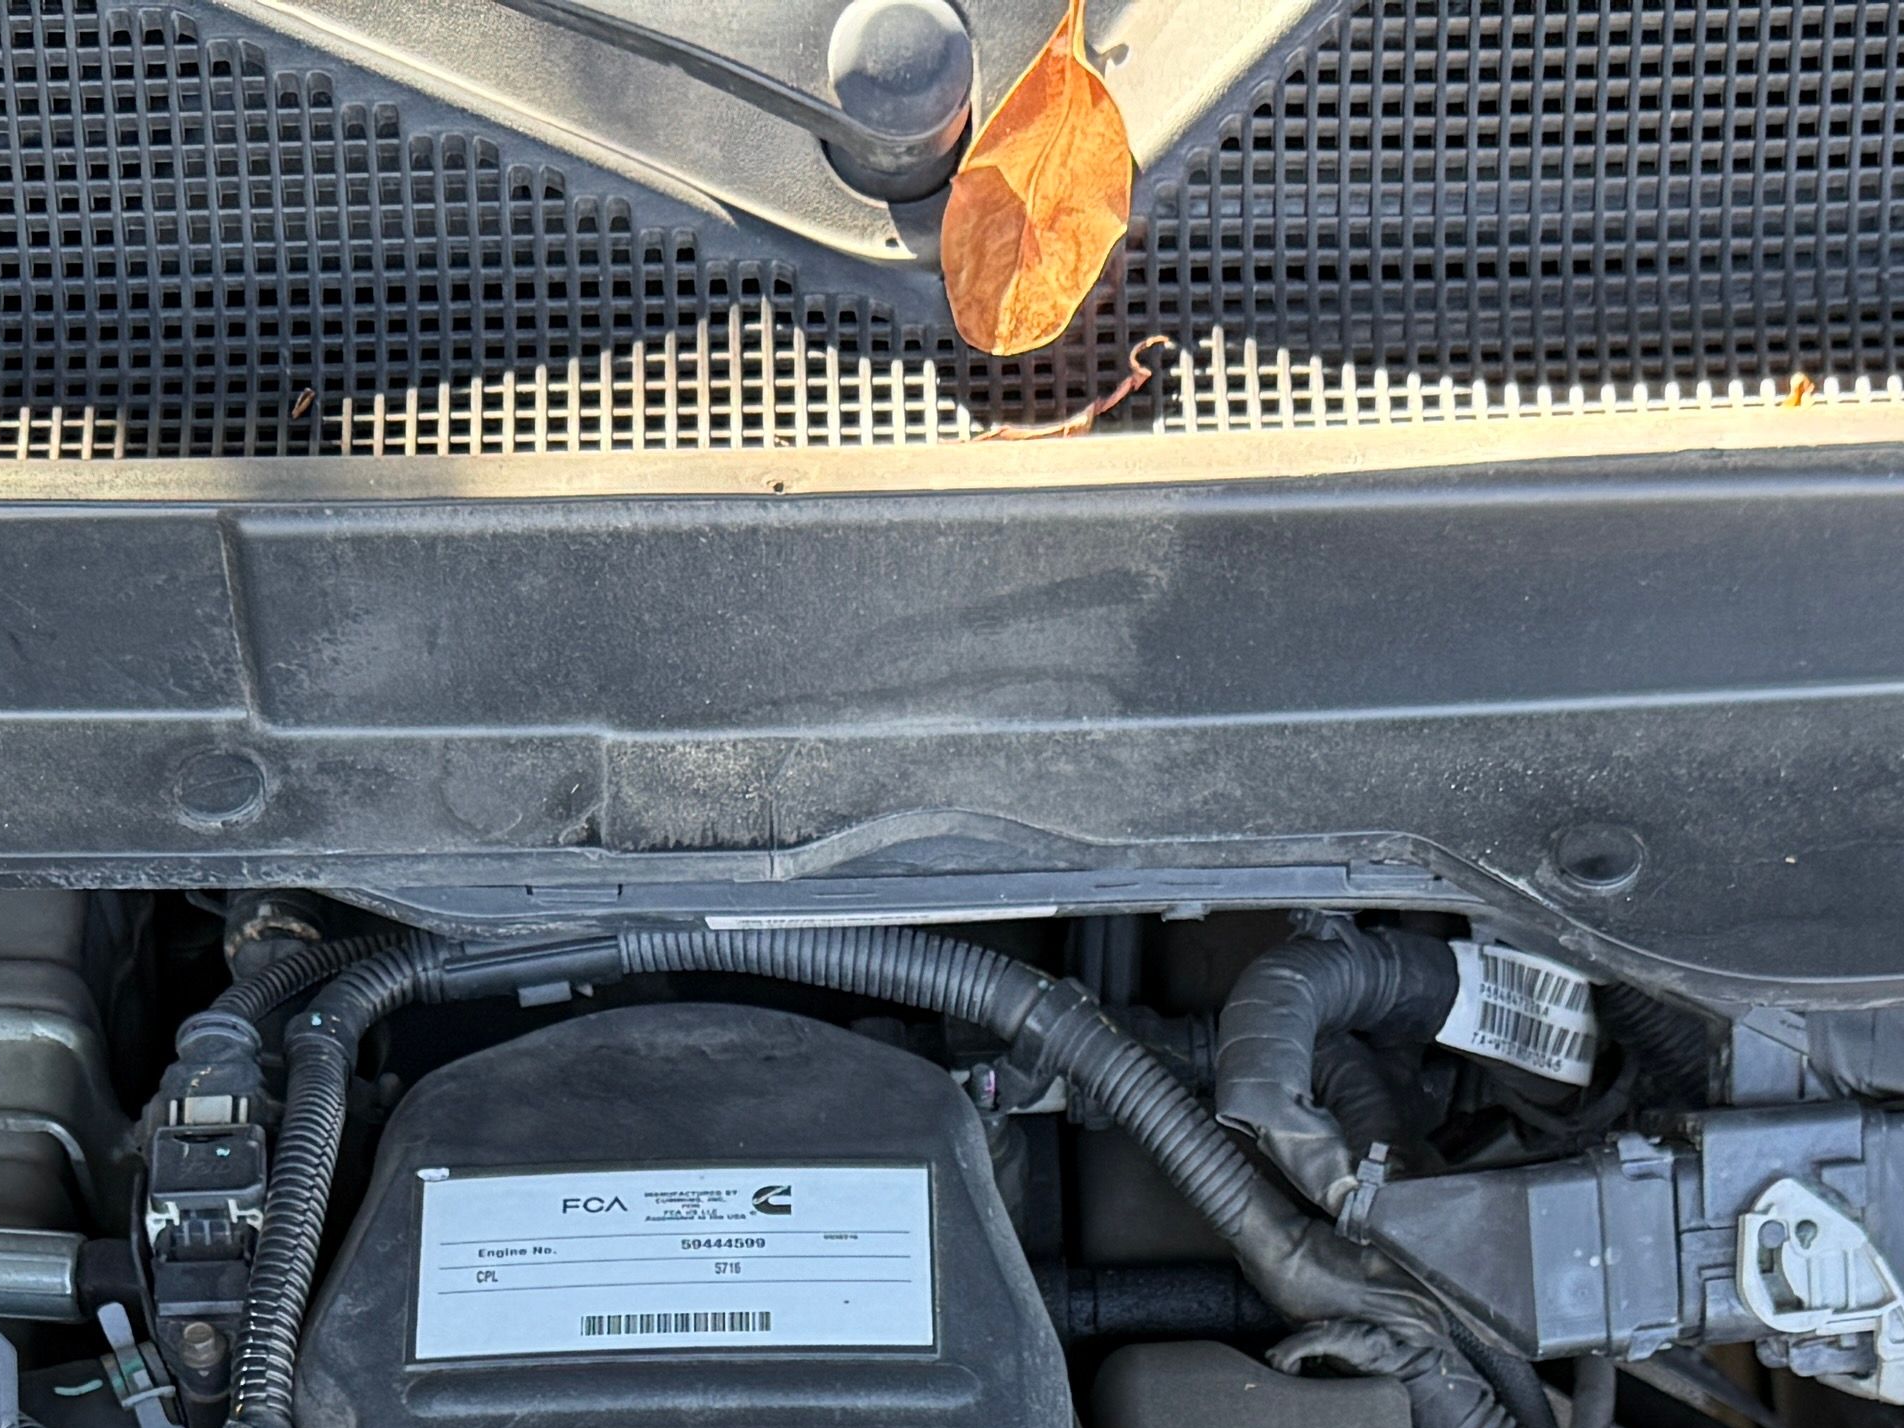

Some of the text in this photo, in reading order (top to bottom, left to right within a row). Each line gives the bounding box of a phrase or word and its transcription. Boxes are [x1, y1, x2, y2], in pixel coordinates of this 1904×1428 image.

[562, 1196, 628, 1214] FCA
[478, 1246, 558, 1259] Engine No.
[476, 1270, 499, 1284] CPL
